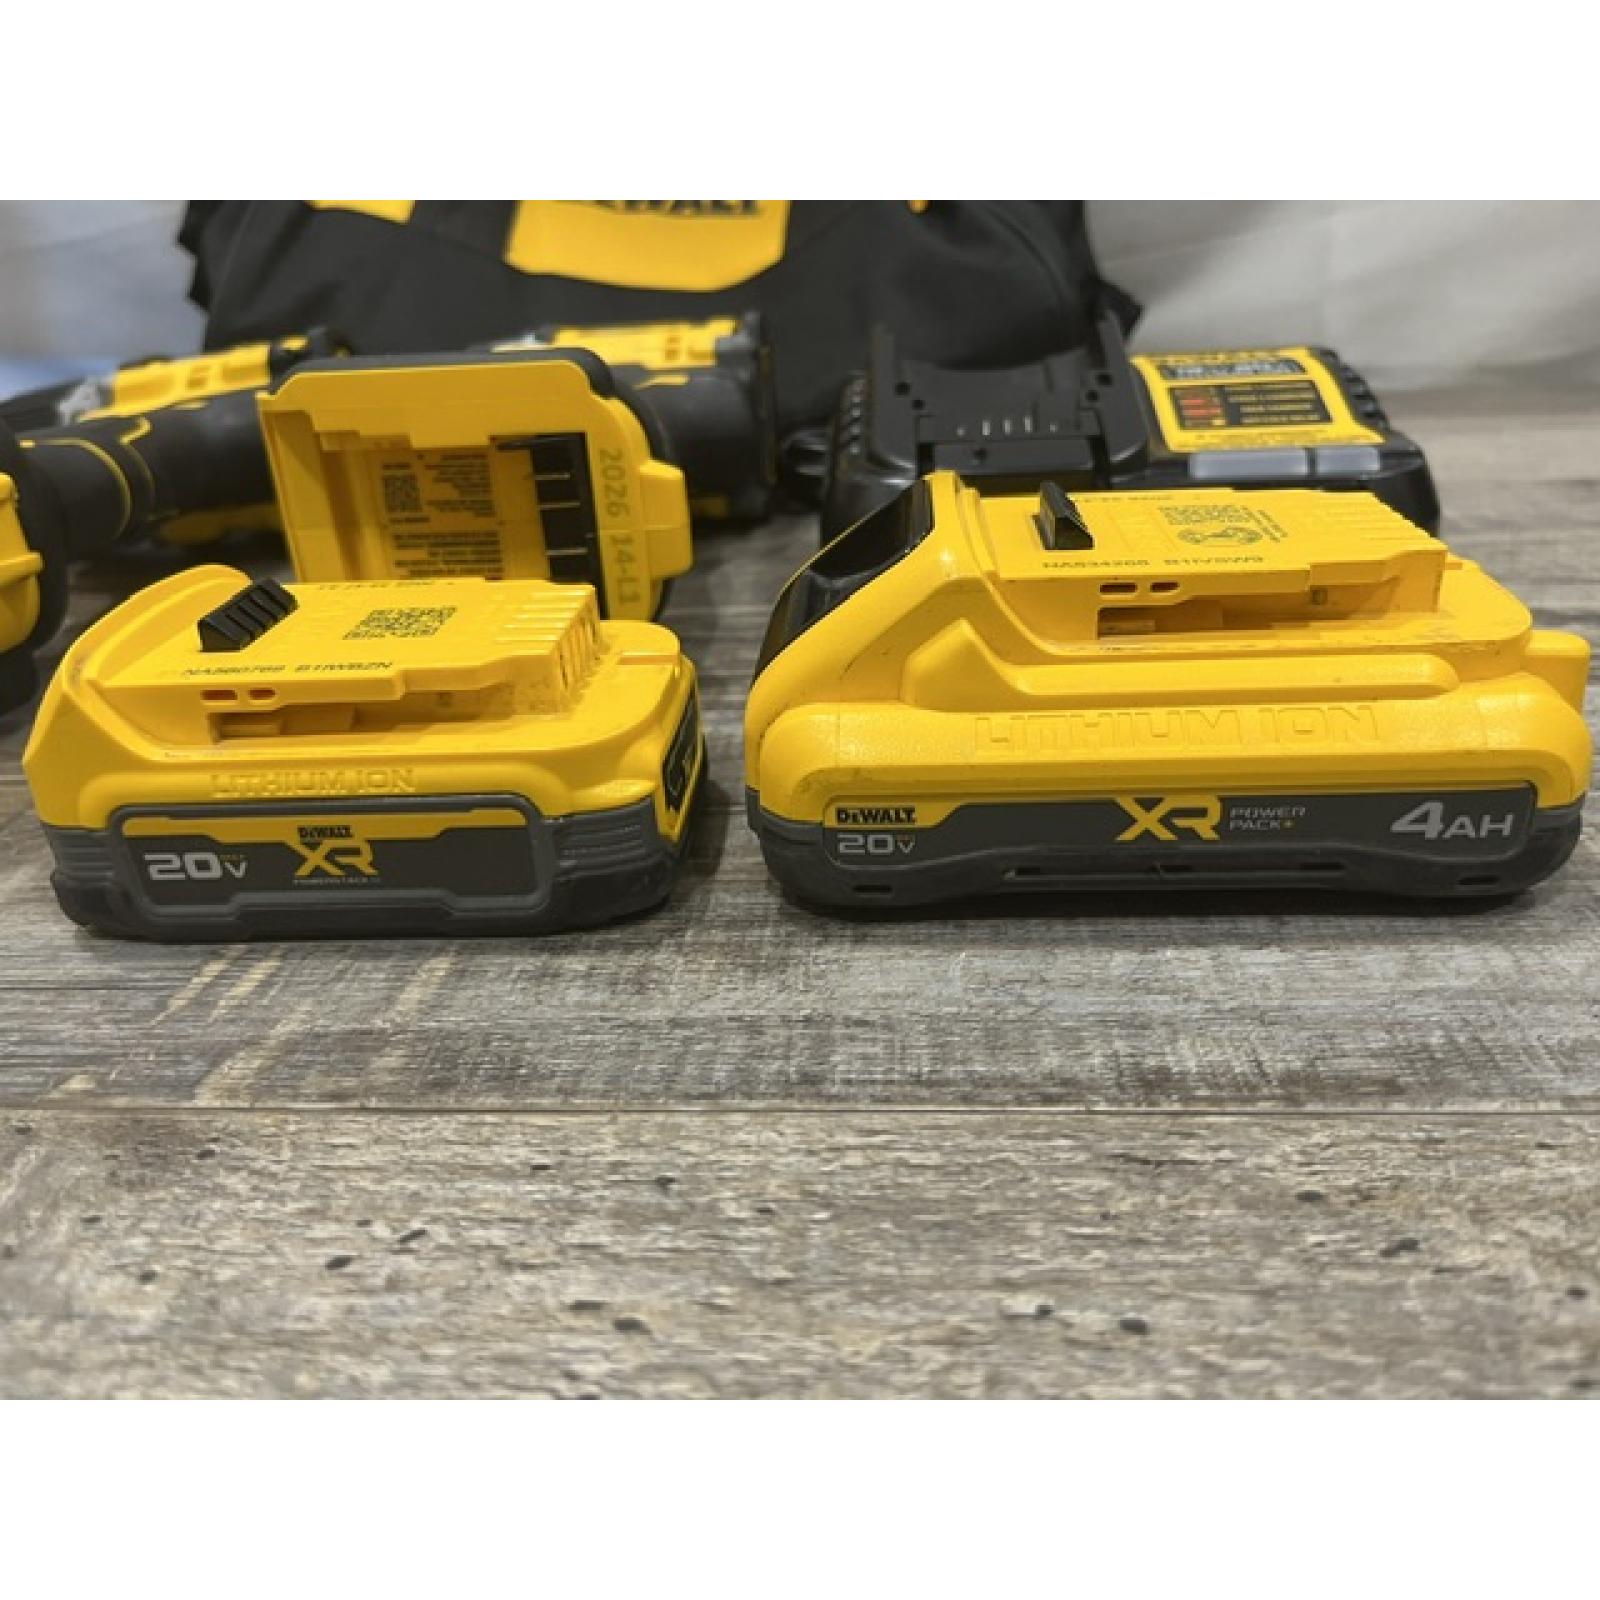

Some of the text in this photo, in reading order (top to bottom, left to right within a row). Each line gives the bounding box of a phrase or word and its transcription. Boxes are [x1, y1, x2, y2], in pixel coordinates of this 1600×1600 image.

[974, 705, 1380, 754] LITHIUM ION
[210, 768, 416, 799] LITHIUM ION
[1114, 797, 1221, 841] XR
[1230, 807, 1306, 819] POWER
[1390, 801, 1514, 840] 4AH
[288, 838, 379, 876] XR
